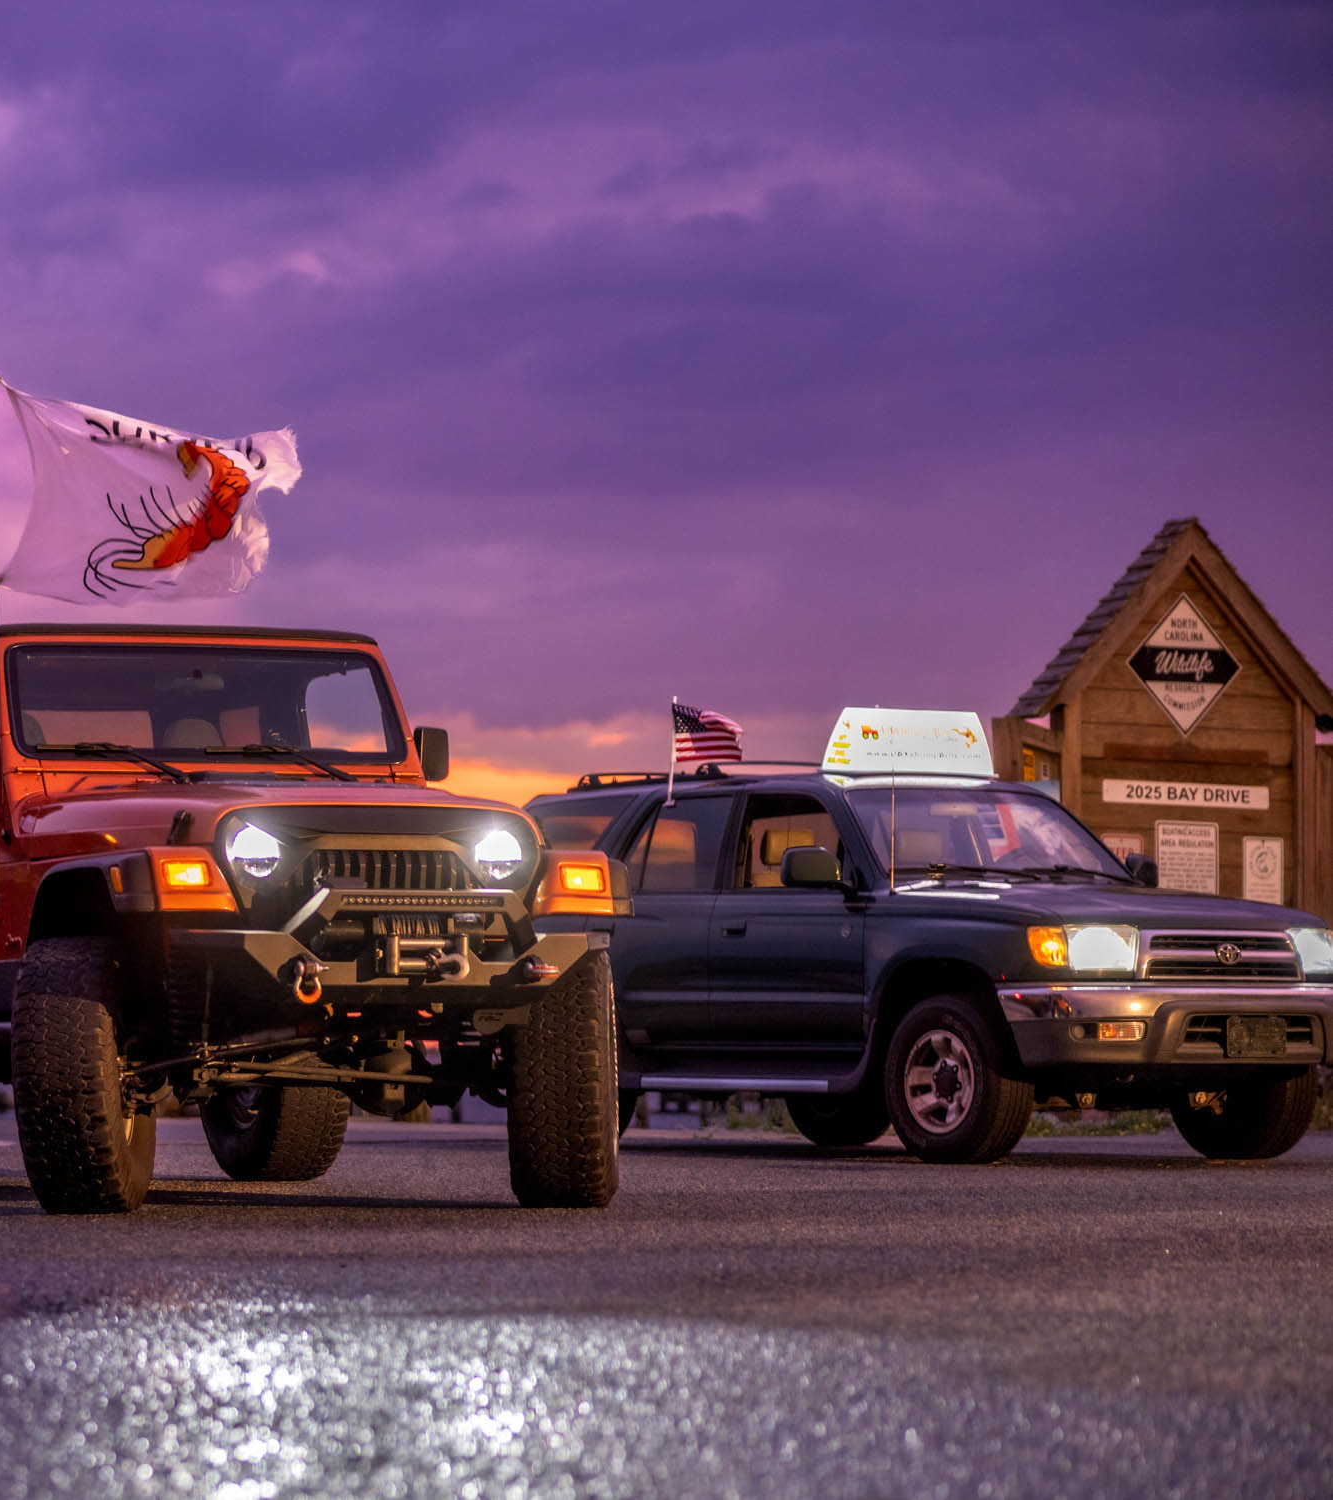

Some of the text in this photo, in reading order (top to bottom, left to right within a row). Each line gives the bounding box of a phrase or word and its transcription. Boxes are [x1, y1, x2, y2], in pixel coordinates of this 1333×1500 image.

[1170, 618, 1198, 630] NORTH
[1164, 630, 1204, 642] CAROLINA
[1154, 649, 1215, 681] Wildlife
[1125, 784, 1251, 804] 2025 BAY DRIVE
